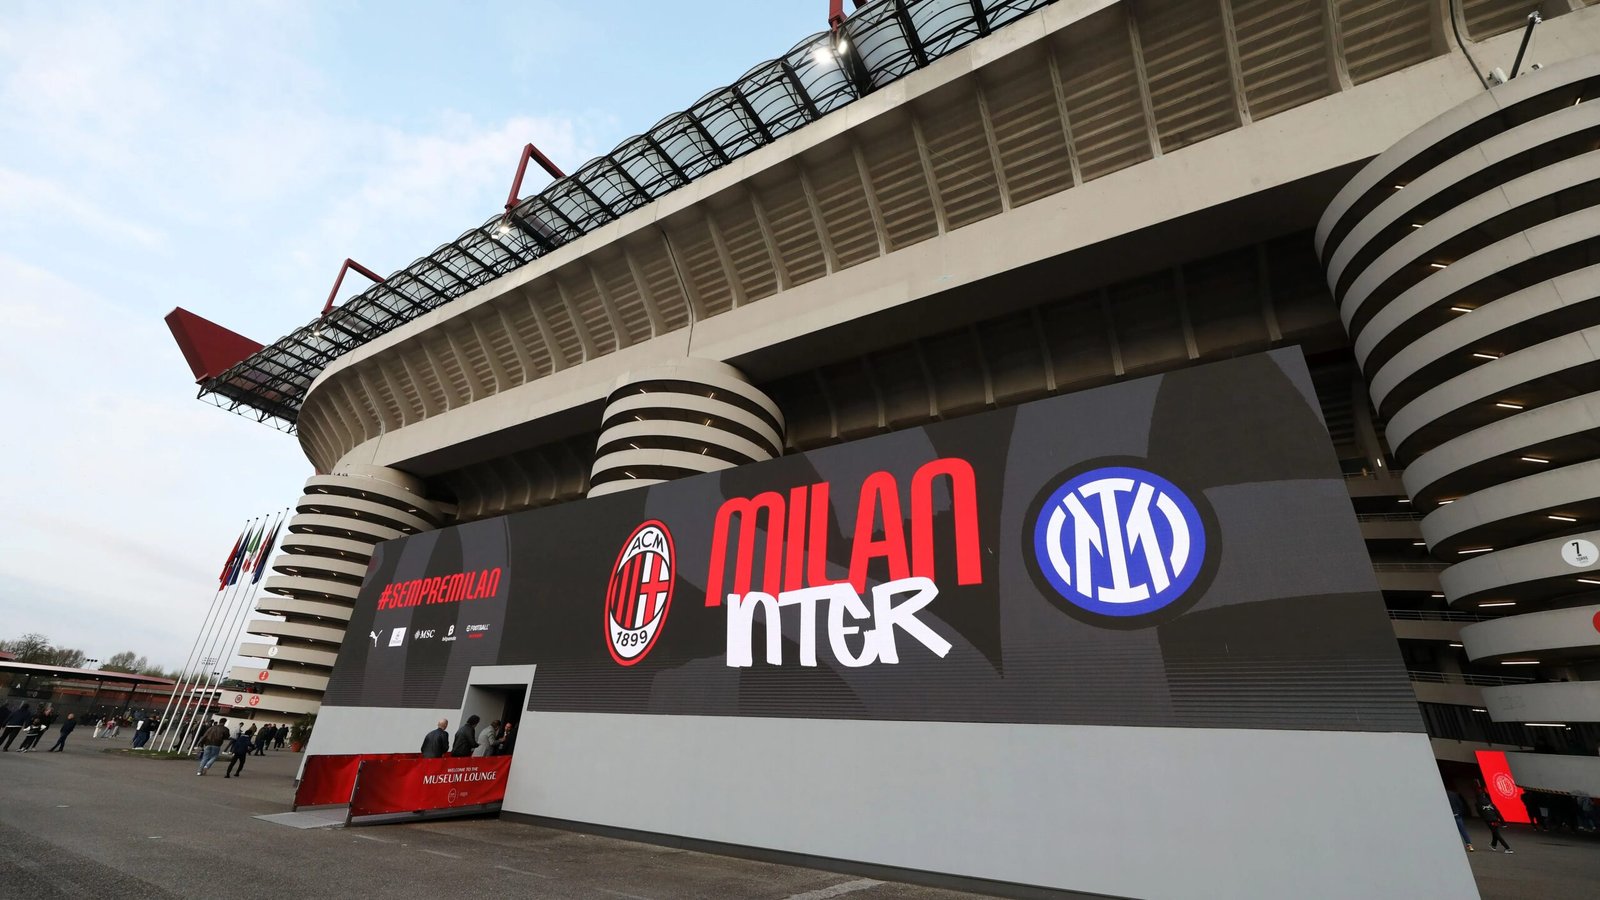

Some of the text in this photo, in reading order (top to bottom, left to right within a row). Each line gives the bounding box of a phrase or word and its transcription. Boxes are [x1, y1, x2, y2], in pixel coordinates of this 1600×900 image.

[705, 457, 982, 607] MILAN
[628, 531, 664, 557] ACM
[1571, 541, 1581, 556] 7
[377, 567, 501, 610] #SEMPREMILAN
[420, 629, 435, 639] MSC
[616, 630, 648, 647] 1899
[423, 771, 496, 784] MUSEUM LOUNGE
